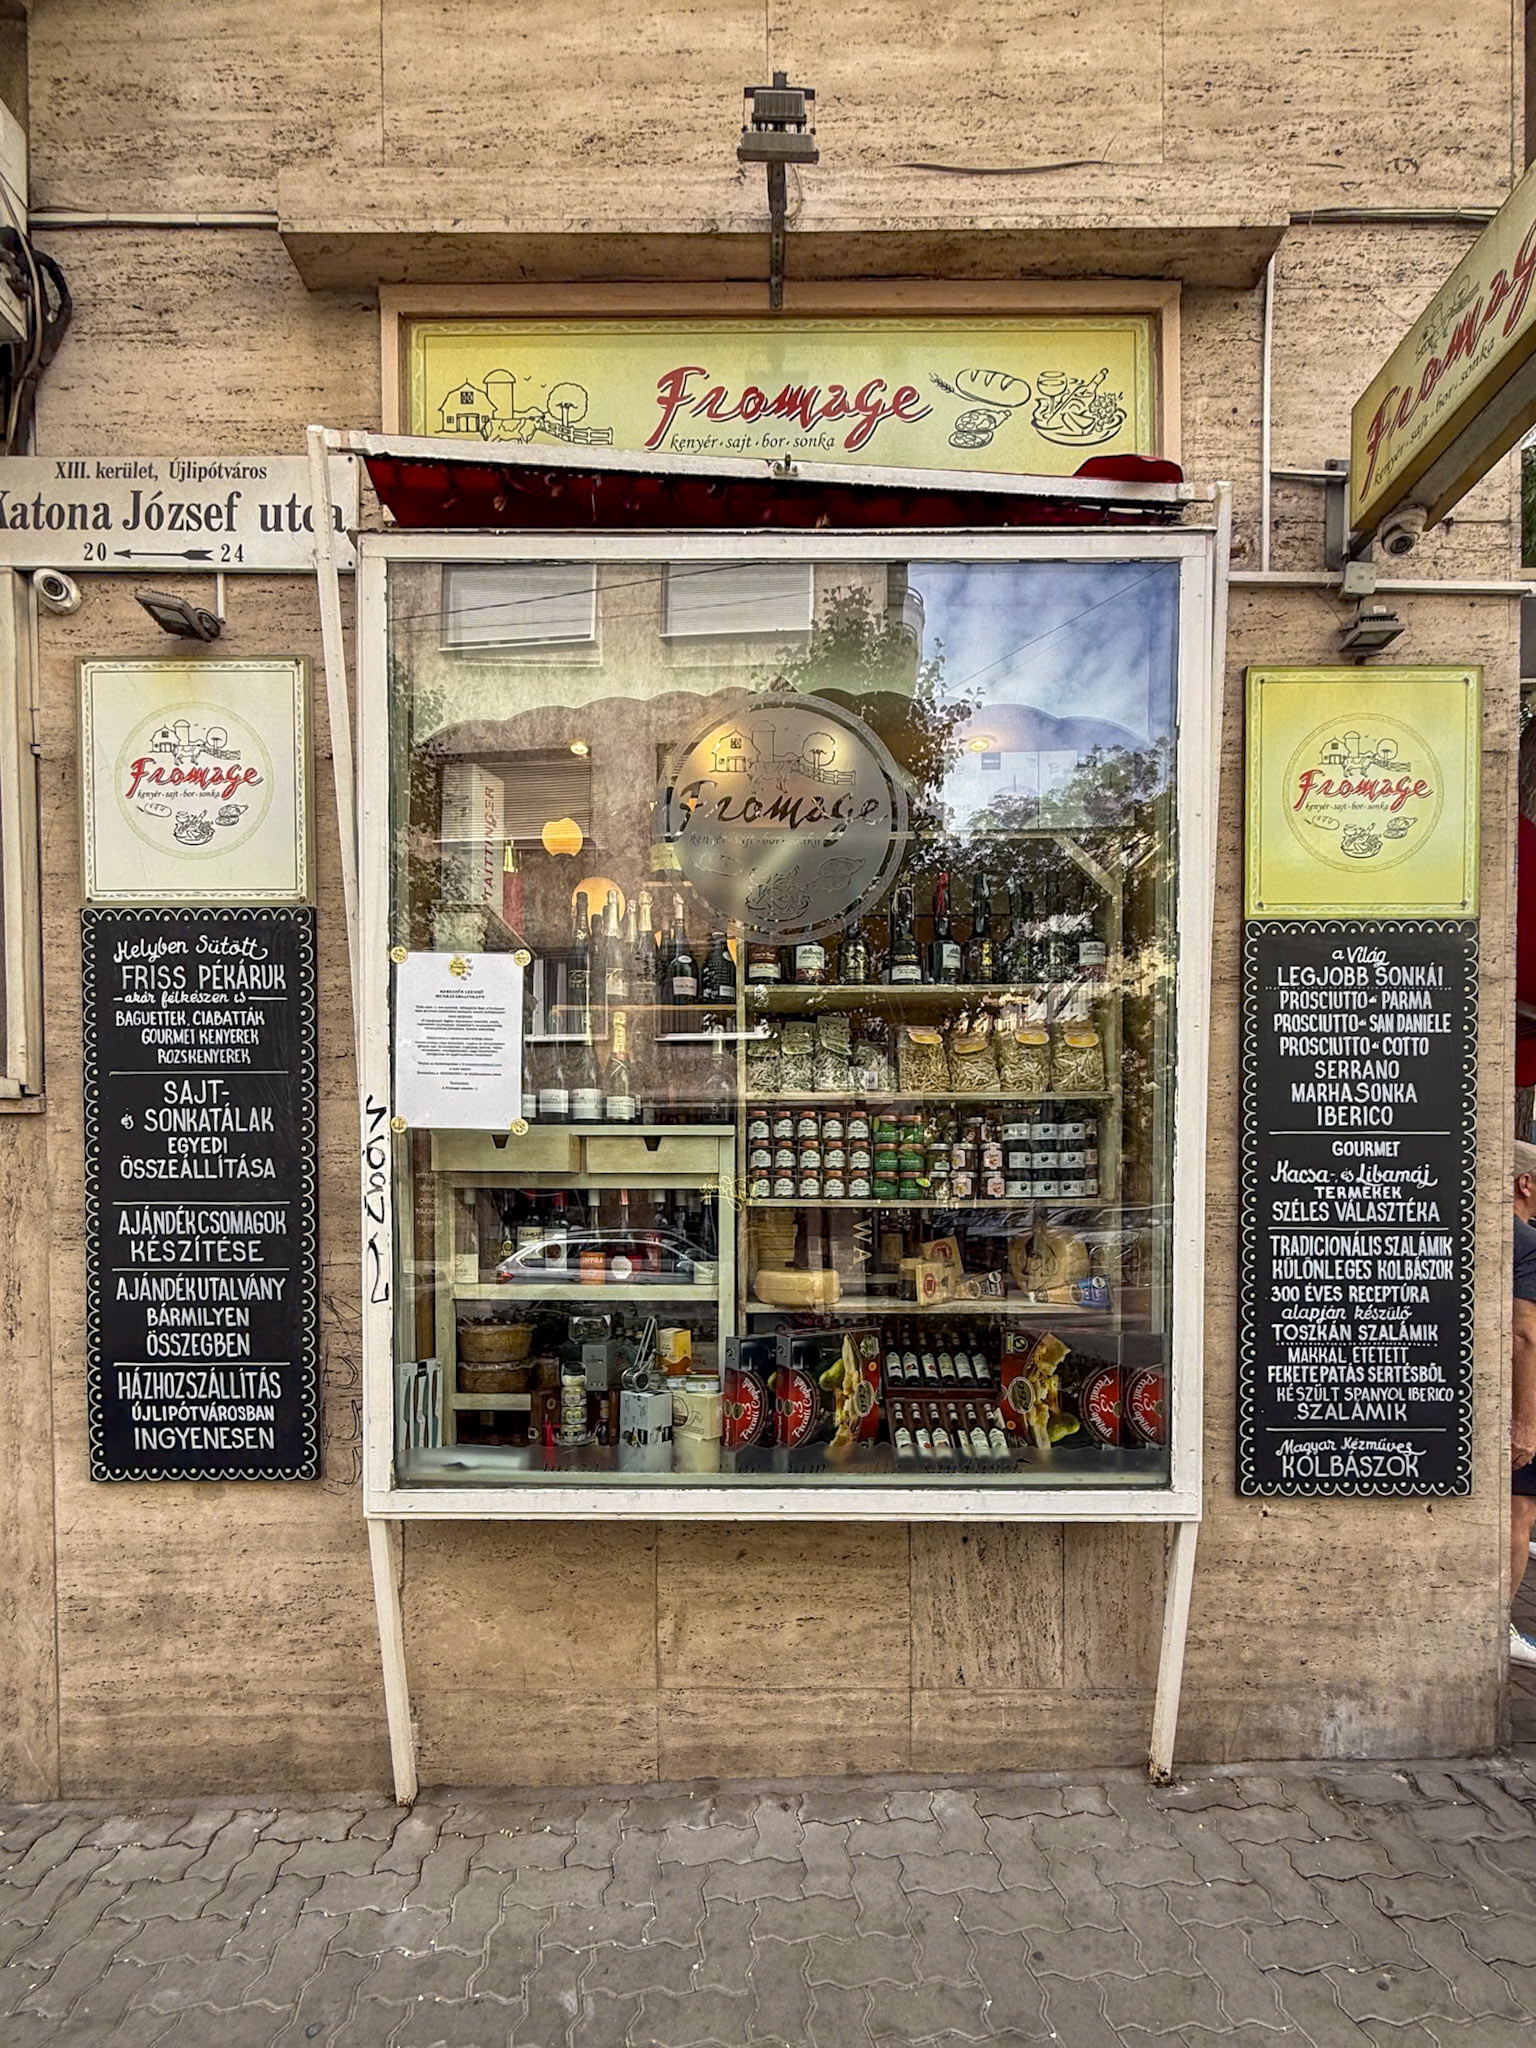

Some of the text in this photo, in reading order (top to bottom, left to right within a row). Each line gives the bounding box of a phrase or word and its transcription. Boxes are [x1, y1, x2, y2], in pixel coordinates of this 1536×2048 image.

[644, 366, 933, 452] Fromage
[1373, 337, 1496, 487] kenyér sajt bor sonka
[670, 432, 836, 453] kenyér sajt bor sonka
[55, 458, 268, 483] XIII. kerület, Újlipótváros
[122, 490, 242, 532] József
[83, 542, 245, 563] 20 24
[125, 757, 265, 801] Fromage
[137, 789, 221, 801] kenyér sajt bor sonka
[1293, 769, 1434, 813] Fromage
[664, 780, 889, 848] Fromage
[1305, 801, 1389, 813] kenyér sajt bor sonka
[113, 935, 268, 963] Helyben Sütött
[1331, 946, 1390, 968] a Világ
[122, 959, 287, 990] FRISS PÉKÁRUK
[1277, 962, 1443, 987] LEGJOBB SONKÁI
[124, 989, 246, 1008] akár félkészen is
[1279, 991, 1368, 1010] PROSCIUTTO
[1381, 990, 1433, 1010] PARMA
[192, 1007, 265, 1026] CIABATTÁK
[1273, 1013, 1359, 1033] PROSCIUTTO
[1369, 1013, 1395, 1033] SAN
[1397, 1013, 1452, 1034] DANIELE
[141, 1028, 260, 1045] GOURMET KENYEREK
[1279, 1036, 1370, 1056] PROSCIUTTO
[1382, 1036, 1430, 1056] COTTO
[158, 1048, 251, 1065] ROZSKENYEREK
[1314, 1059, 1400, 1080] SERRANO
[163, 1080, 230, 1104] SAJT-
[1291, 1082, 1418, 1103] MARHASONKA
[120, 1102, 275, 1132] és SONKATÁLAK
[1317, 1105, 1394, 1126] IBERICO
[168, 1136, 228, 1154] EGYEDI
[1332, 1140, 1401, 1157] GOURMET
[120, 1149, 277, 1180] ÖSSZEÁLLÍTÁSA
[1340, 1167, 1354, 1183] és
[1355, 1163, 1438, 1188] Libamáj
[1313, 1184, 1402, 1199] TERMÉKEK
[1272, 1197, 1441, 1223] SZÉLES VÁLASZTÉKA
[130, 1236, 264, 1263] KÉSZÍTÉSE
[1269, 1231, 1453, 1257] TRADICIONÁLIS SZALÁMIK
[1272, 1256, 1454, 1281] KÜLÖNLEGES KOLBÁSZOK
[1270, 1282, 1430, 1304] 300 ÉVES RECEPTÚRA
[146, 1302, 250, 1327] BÁRMILYEN
[1281, 1304, 1413, 1325] alapján készülő
[1271, 1319, 1439, 1342] TOSZKÁN SZALÁMIK
[146, 1330, 250, 1358] ÖSSZEGBEN
[1287, 1346, 1409, 1364] MAKKAL ETETETT
[117, 1366, 282, 1400] HÁZHOZSZÁLLÍTÁS
[1267, 1361, 1446, 1384] FEKETEPATÁS SERTÉSBŐL
[1276, 1383, 1455, 1402] KÉSZÜLT SPANYOL IBERICO
[131, 1400, 275, 1422] ÚJLIPÓTVÁROSBAN
[1296, 1397, 1408, 1422] SZALÁMIK
[134, 1427, 275, 1450] INGYENESEN
[1275, 1436, 1427, 1457] Magyar Kézműves
[1282, 1449, 1419, 1478] KOLBÁSZOK
